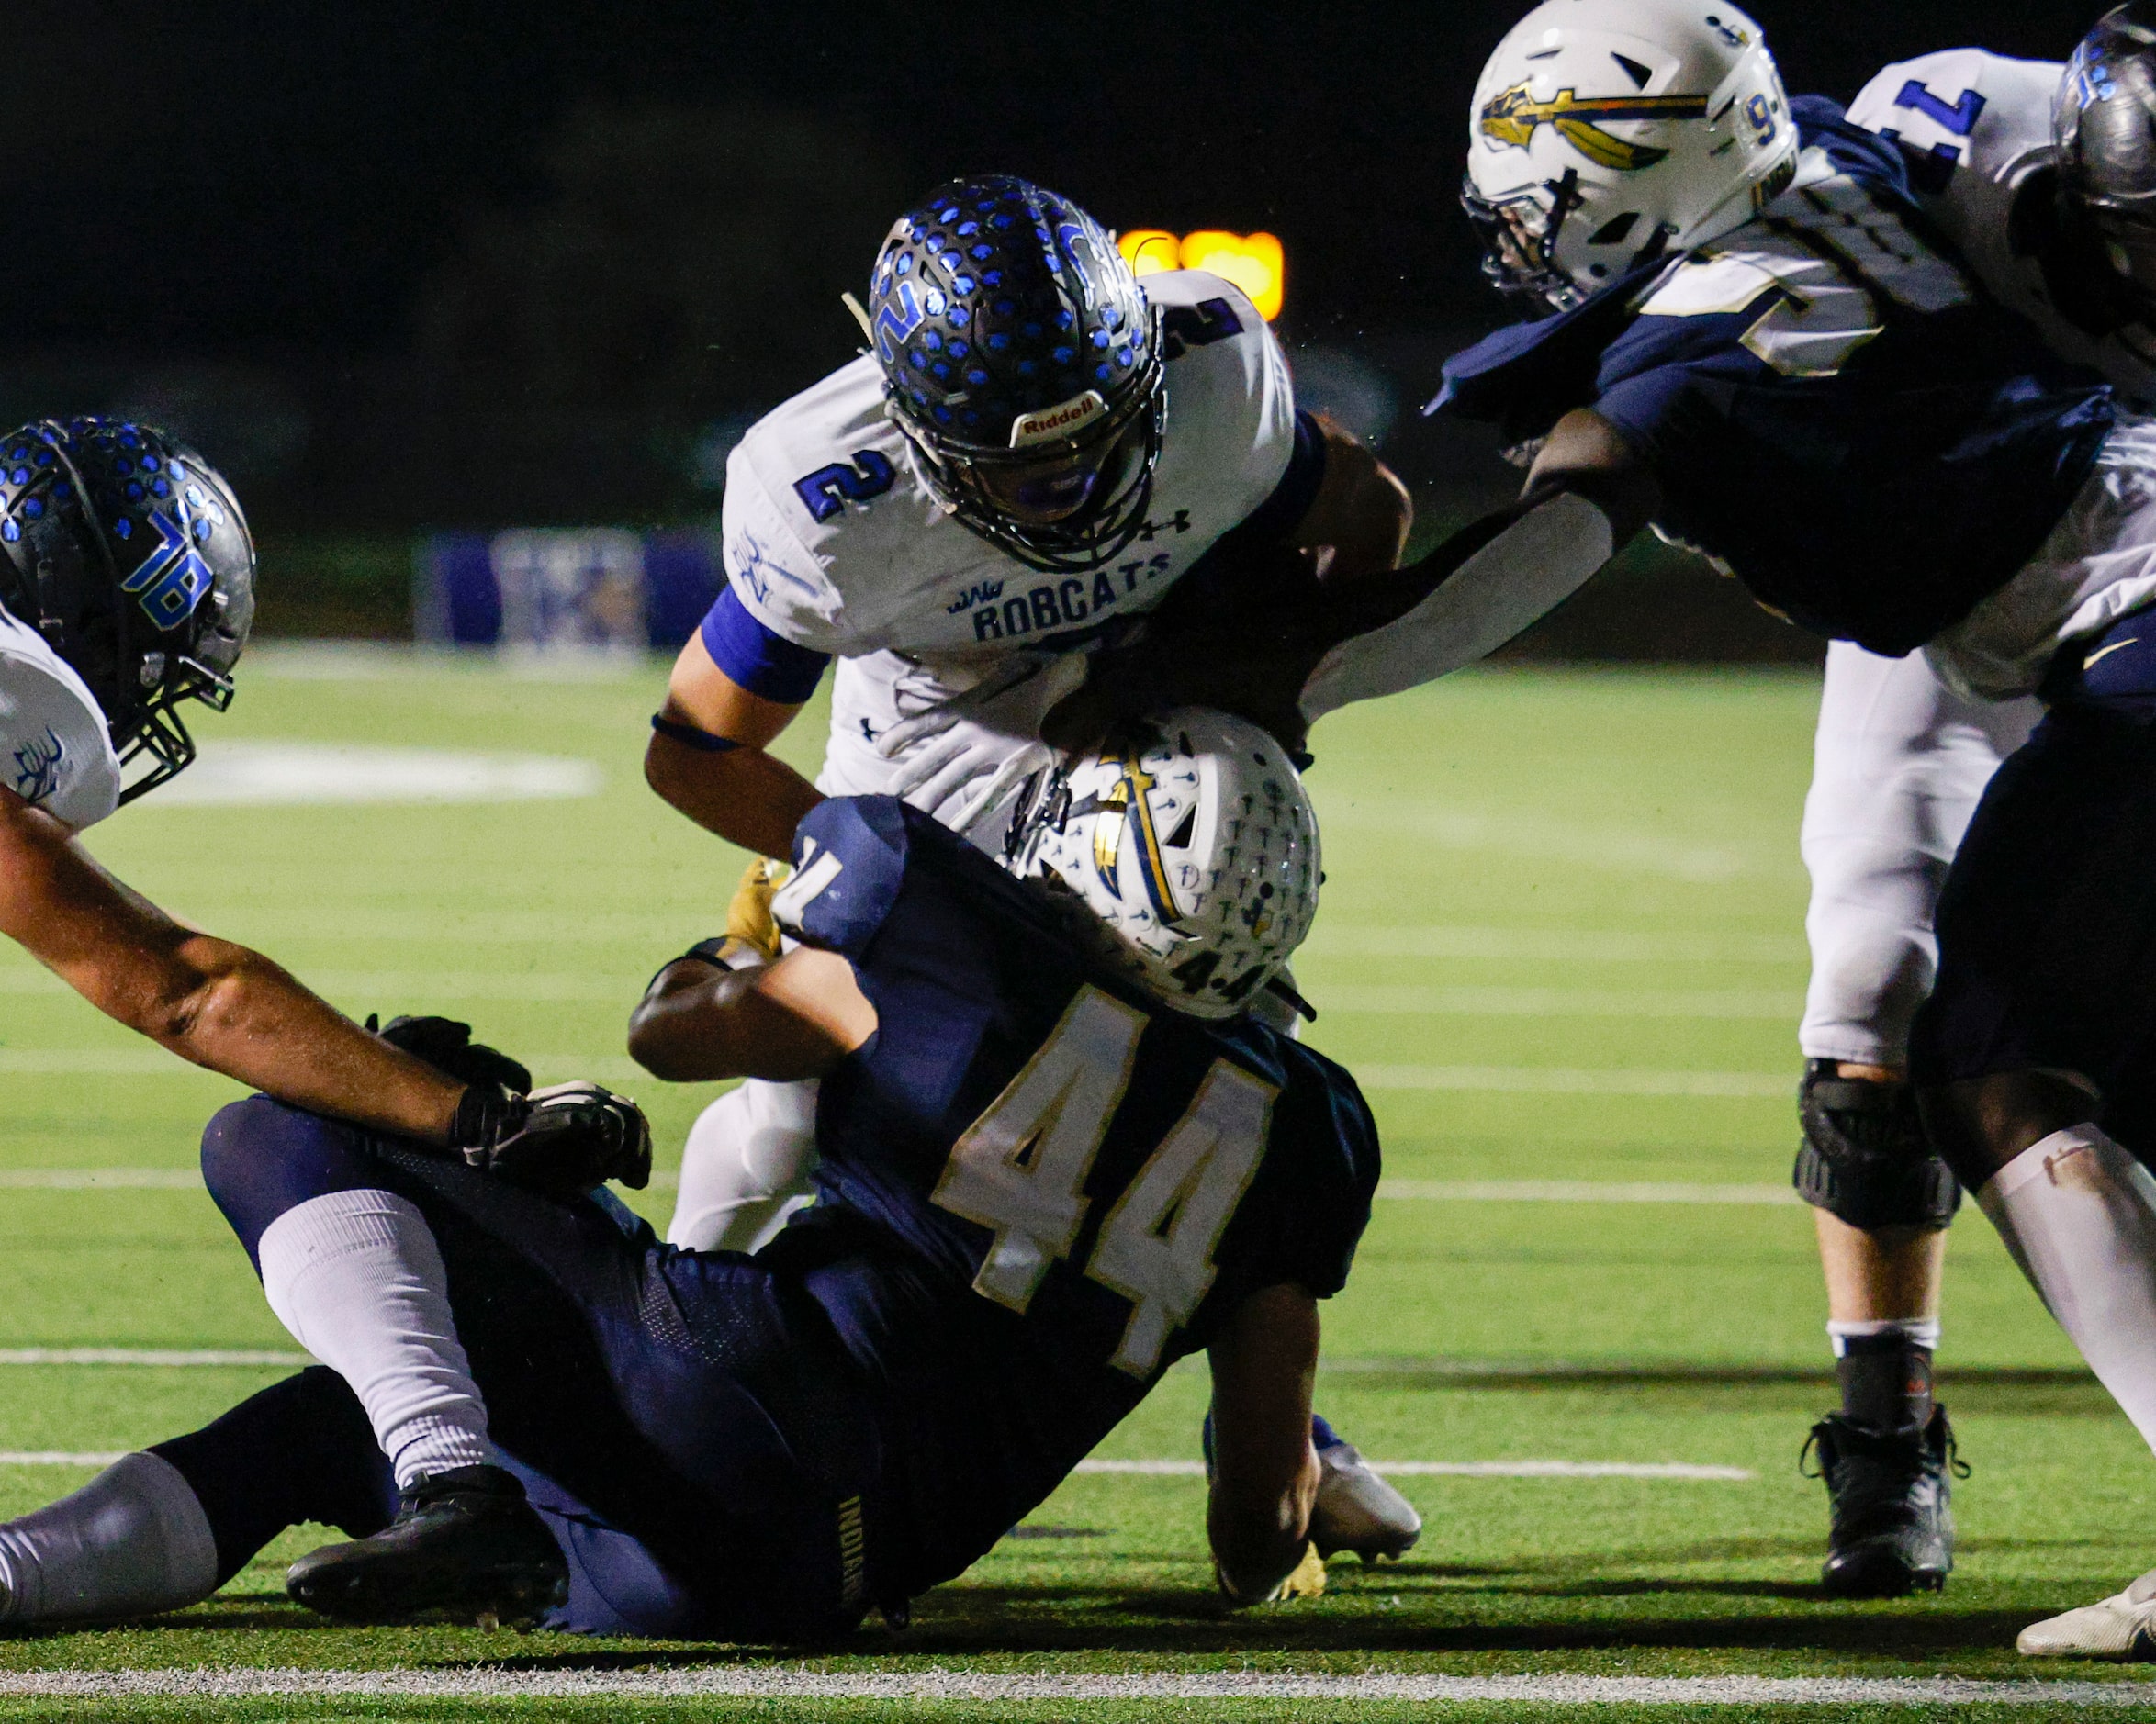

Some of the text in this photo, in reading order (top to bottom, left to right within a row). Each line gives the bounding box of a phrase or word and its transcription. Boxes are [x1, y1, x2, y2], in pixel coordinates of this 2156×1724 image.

[1024, 397, 1094, 434] Riddell
[792, 449, 897, 524] 2
[120, 509, 214, 632] 78
[928, 980, 1283, 1382] 44
